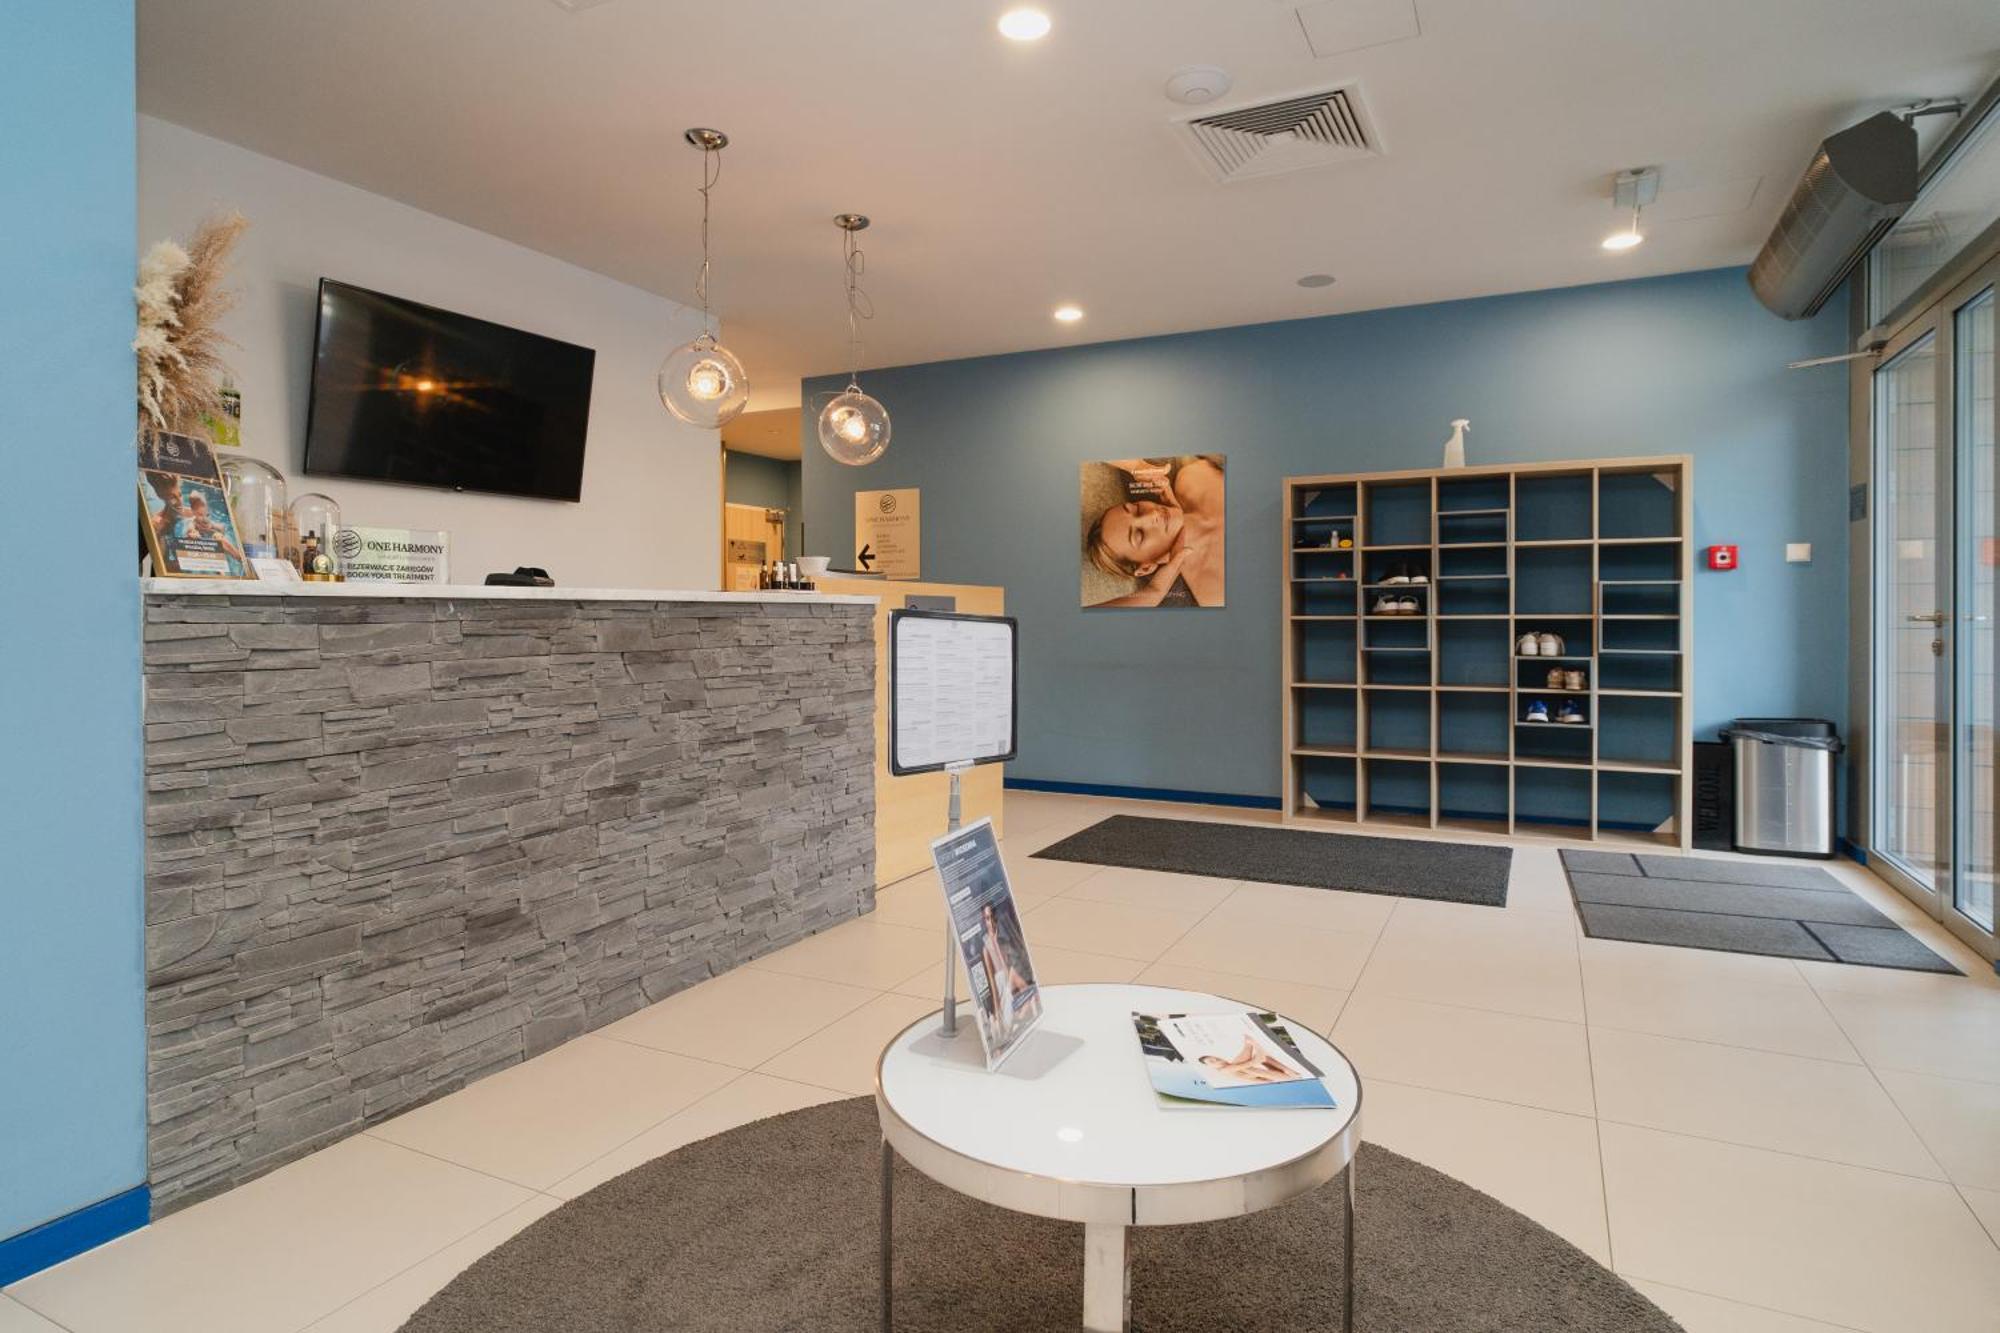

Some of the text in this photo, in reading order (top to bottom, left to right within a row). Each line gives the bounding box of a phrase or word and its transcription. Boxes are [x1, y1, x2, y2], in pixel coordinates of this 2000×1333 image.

[367, 541, 444, 554] ONE HARMONY
[347, 563, 434, 573] REZERWACJE ZABIEGÓW
[393, 573, 435, 581] TREATMENT
